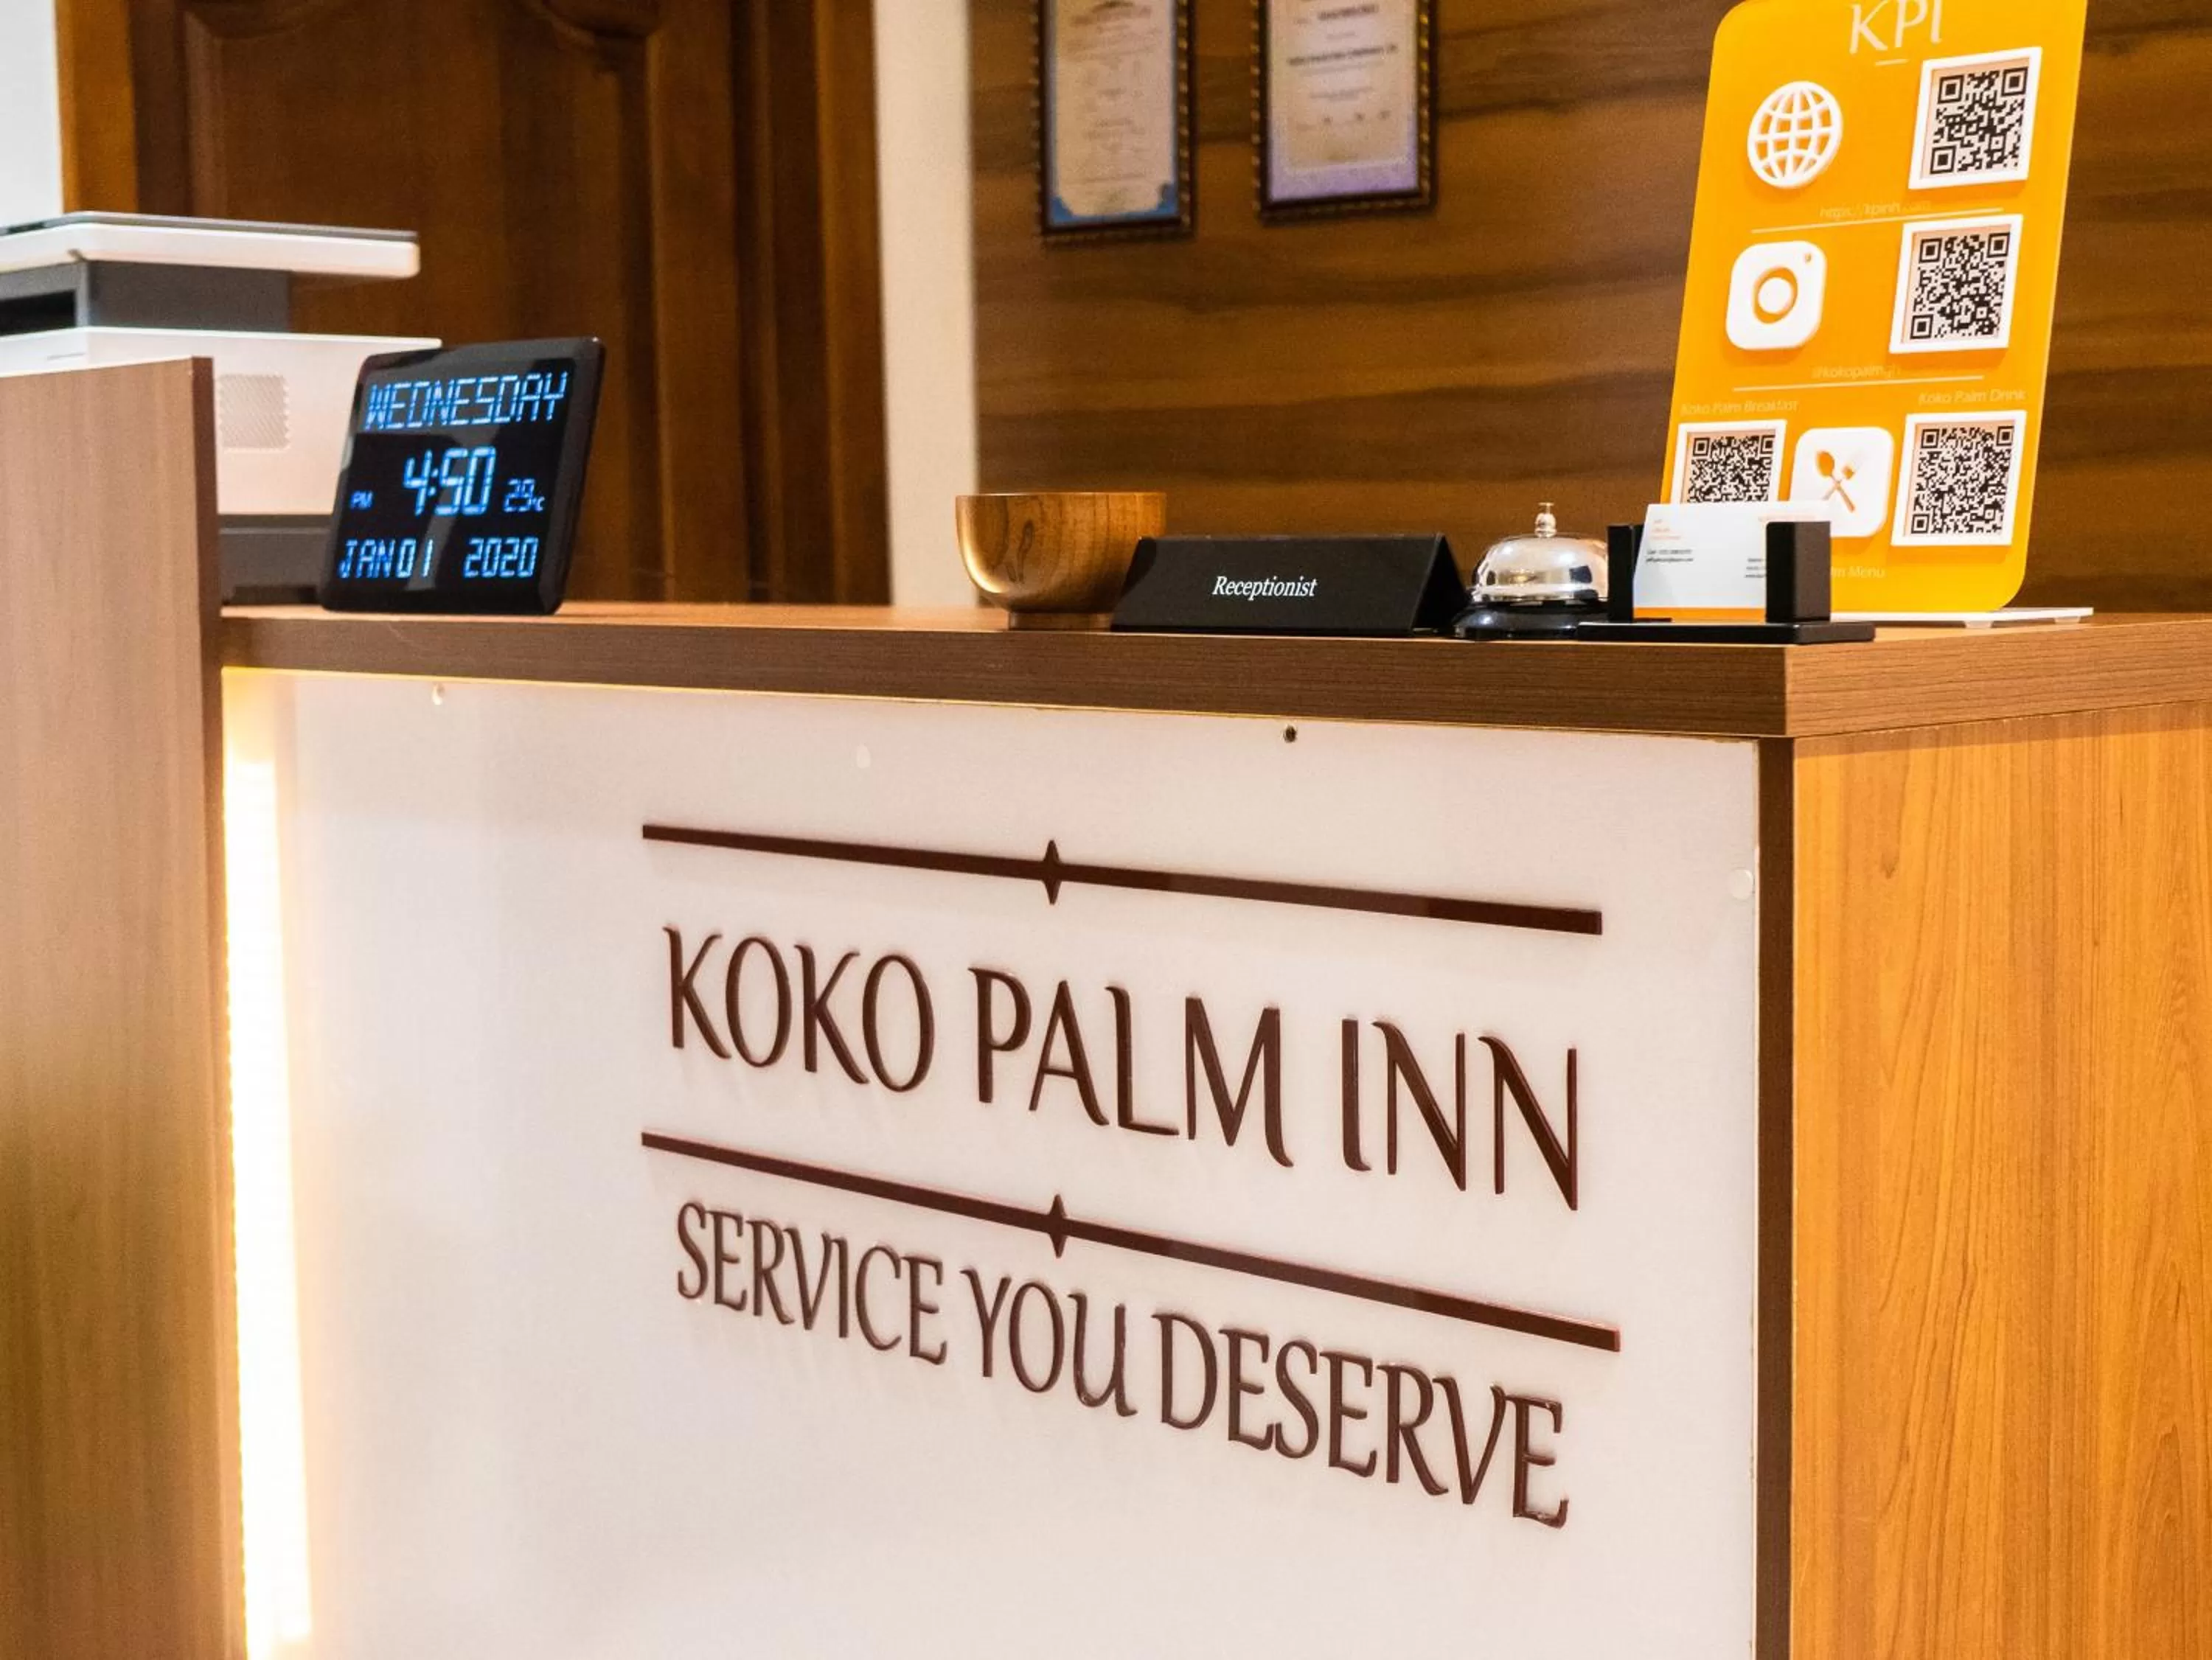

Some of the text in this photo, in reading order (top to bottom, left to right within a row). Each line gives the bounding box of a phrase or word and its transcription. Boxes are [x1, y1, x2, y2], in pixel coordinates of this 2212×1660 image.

[1848, 0, 1942, 55] KPI
[366, 372, 568, 430] WEDNESDAY
[1680, 399, 1798, 416] Koko Palm Breakfast
[1918, 392, 1952, 405] Koko
[1954, 390, 1986, 402] Palm
[350, 447, 496, 516] PM 4:50
[464, 537, 539, 579] 2020
[1848, 565, 1885, 579] Menu
[1212, 575, 1318, 601] Receptionist
[663, 926, 1578, 1211] KOKO PALM INN
[677, 1202, 1569, 1529] SERVICE YOU DESERVE
